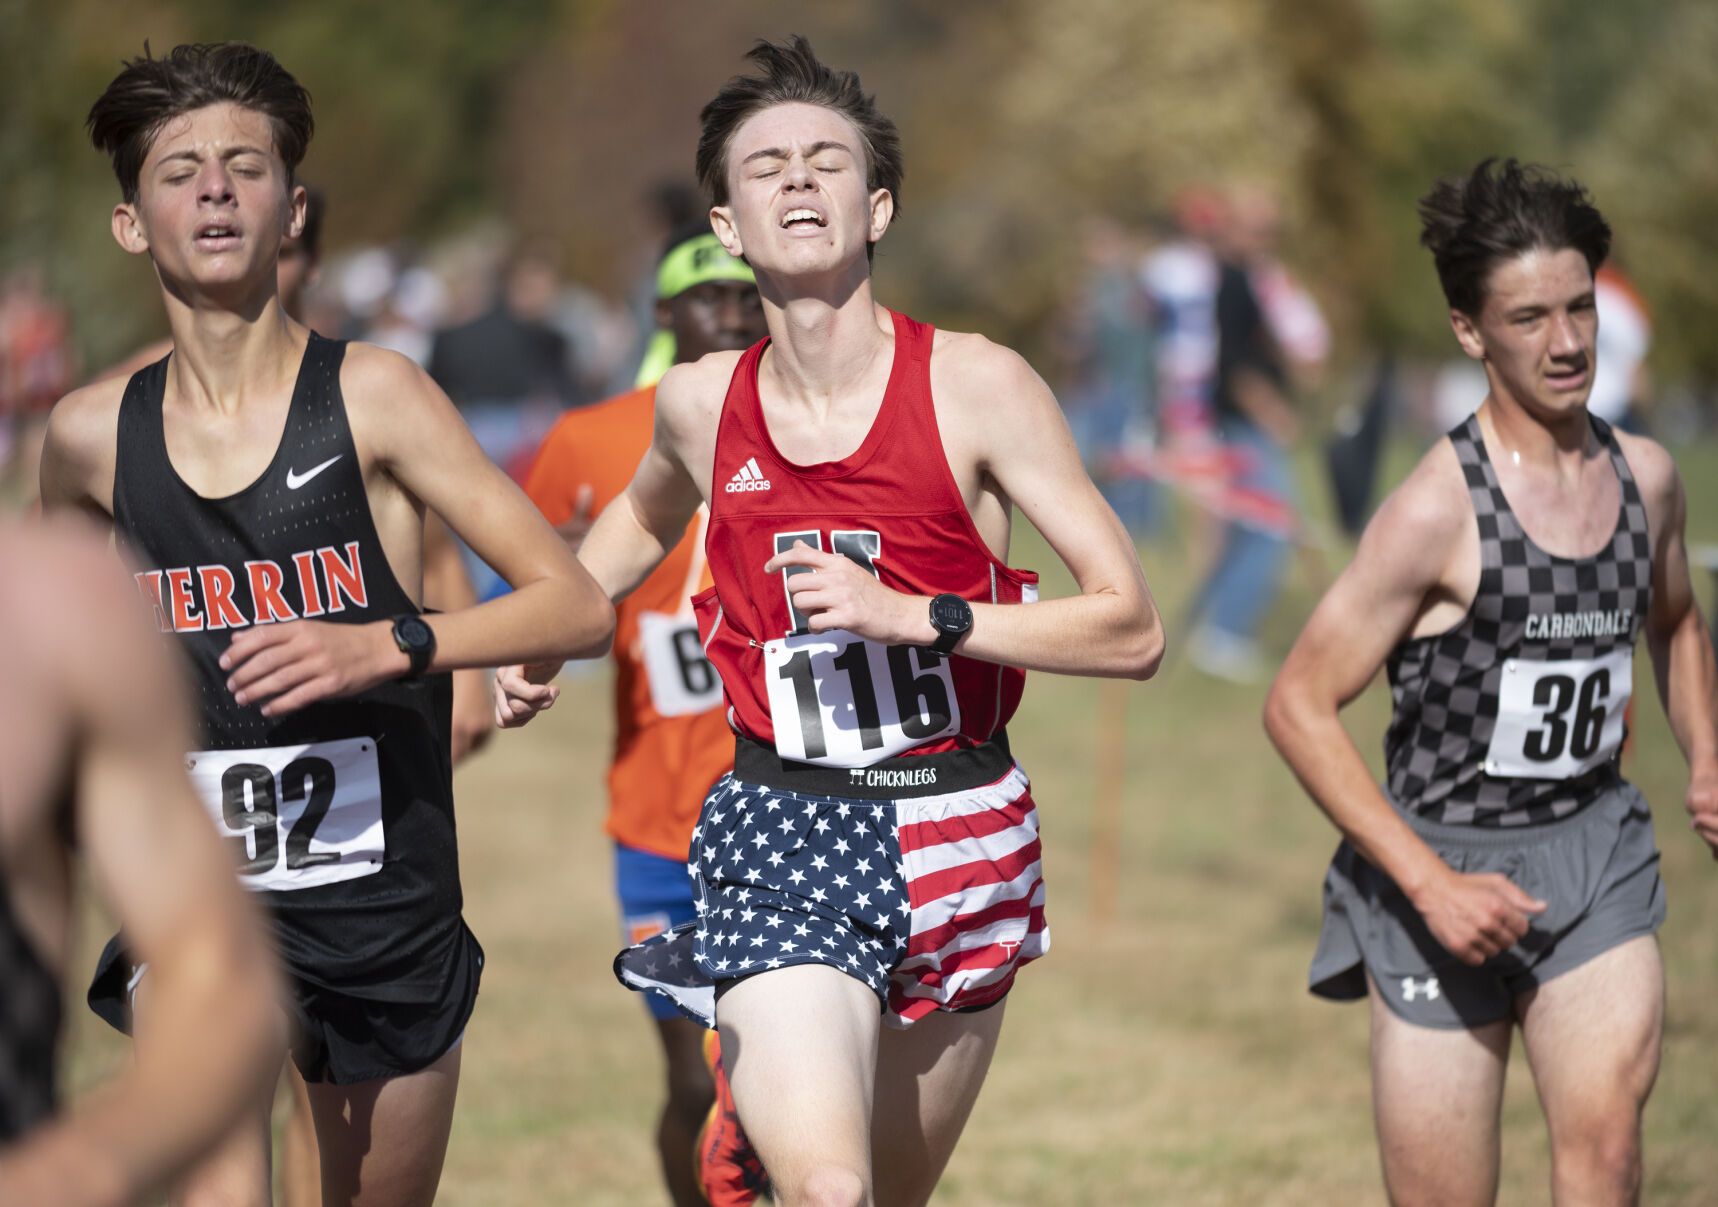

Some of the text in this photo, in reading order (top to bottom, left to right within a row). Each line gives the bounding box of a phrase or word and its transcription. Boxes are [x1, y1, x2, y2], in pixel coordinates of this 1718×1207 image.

[725, 479, 771, 493] adidas
[1525, 609, 1633, 639] CARBONDALE
[779, 641, 952, 759] 116
[1523, 667, 1610, 763] 36
[866, 768, 937, 787] CHICKNLEGS
[221, 756, 341, 875] 92
